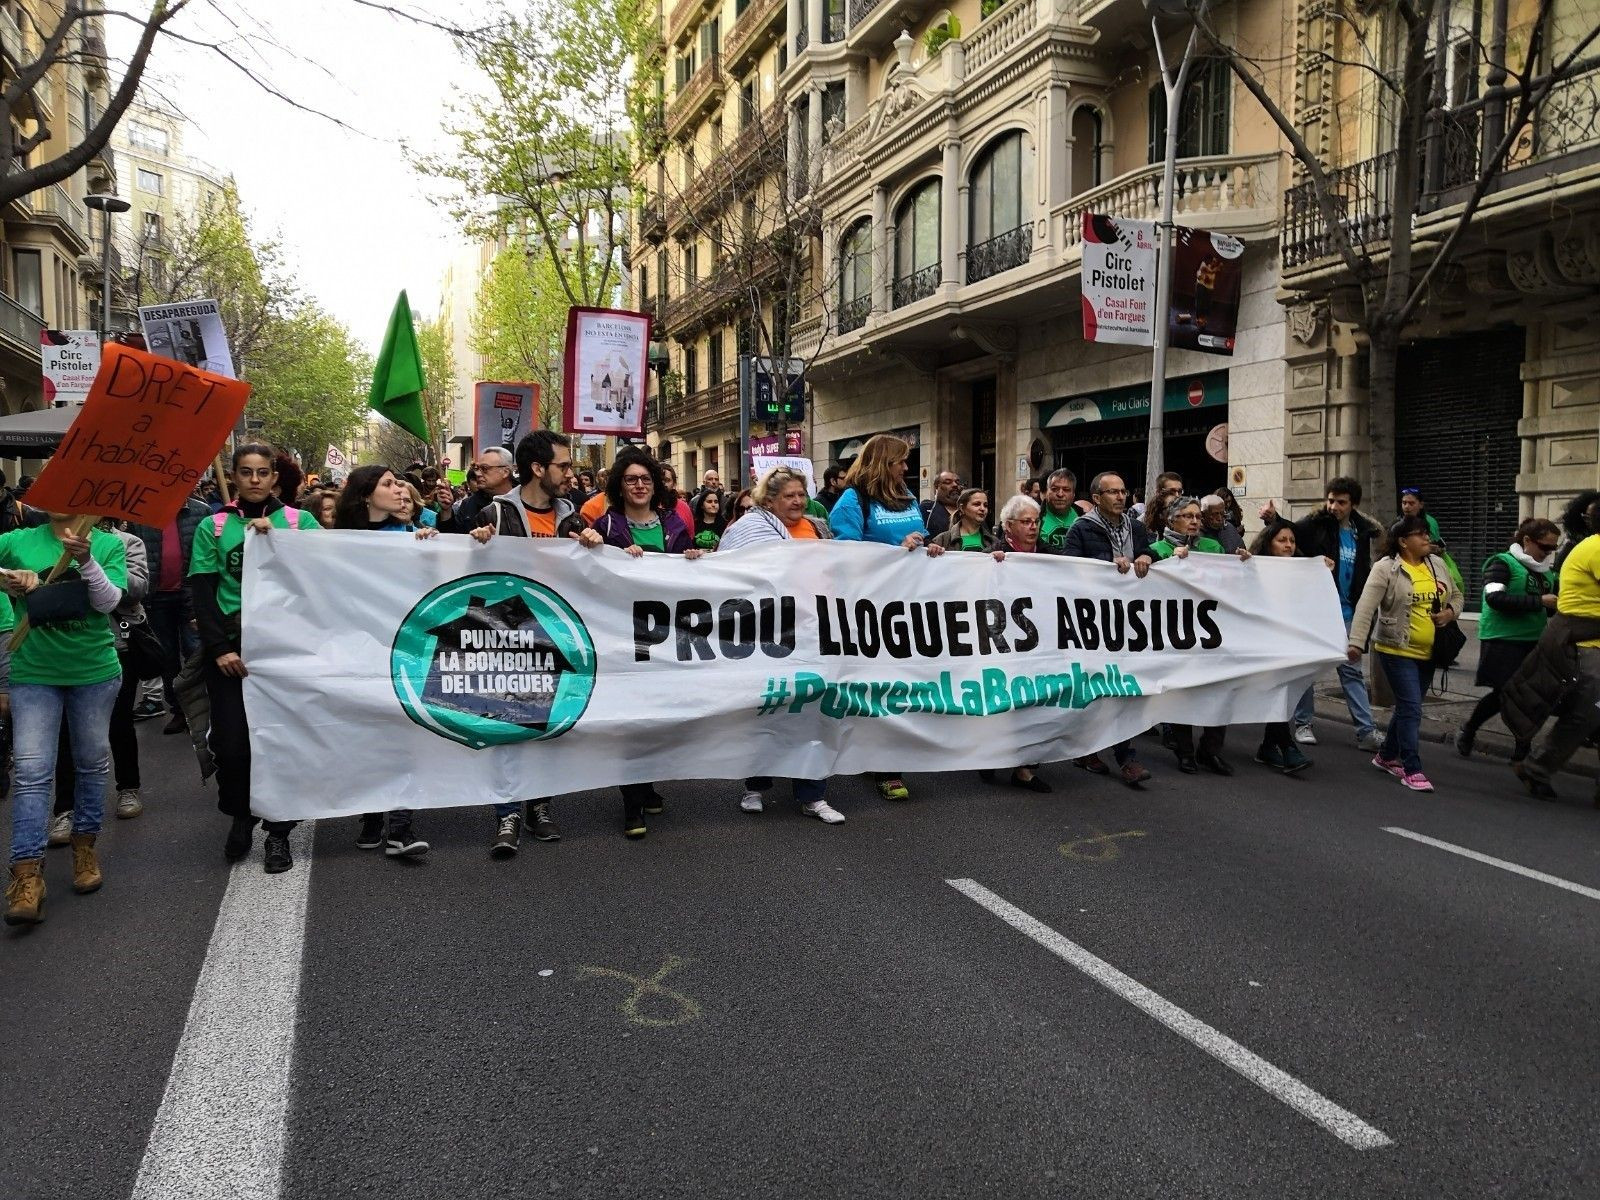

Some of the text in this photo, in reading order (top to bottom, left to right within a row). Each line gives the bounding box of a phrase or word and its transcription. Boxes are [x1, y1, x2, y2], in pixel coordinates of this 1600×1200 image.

[1105, 251, 1132, 272] Circ
[1092, 269, 1145, 292] Pistolet
[143, 304, 217, 321] DESAPAREGUDA
[1105, 296, 1147, 311] Casal Font
[1097, 307, 1146, 324] d'en Fargues
[60, 349, 82, 360] Circ
[50, 360, 93, 371] Pistolet
[106, 353, 227, 415] DRET
[1112, 396, 1150, 412] Pau Claris
[132, 414, 153, 433] a
[61, 427, 199, 488] l'habitatge
[67, 478, 160, 517] DIGNE
[632, 594, 1223, 662] PROU LLOGUERS ABUSIUS
[460, 629, 534, 650] PUNXEM
[439, 651, 555, 673] LA BOMBOLLA
[441, 673, 555, 694] DEL LLOGUER
[756, 662, 1143, 720] #PunxemLaBombolla
